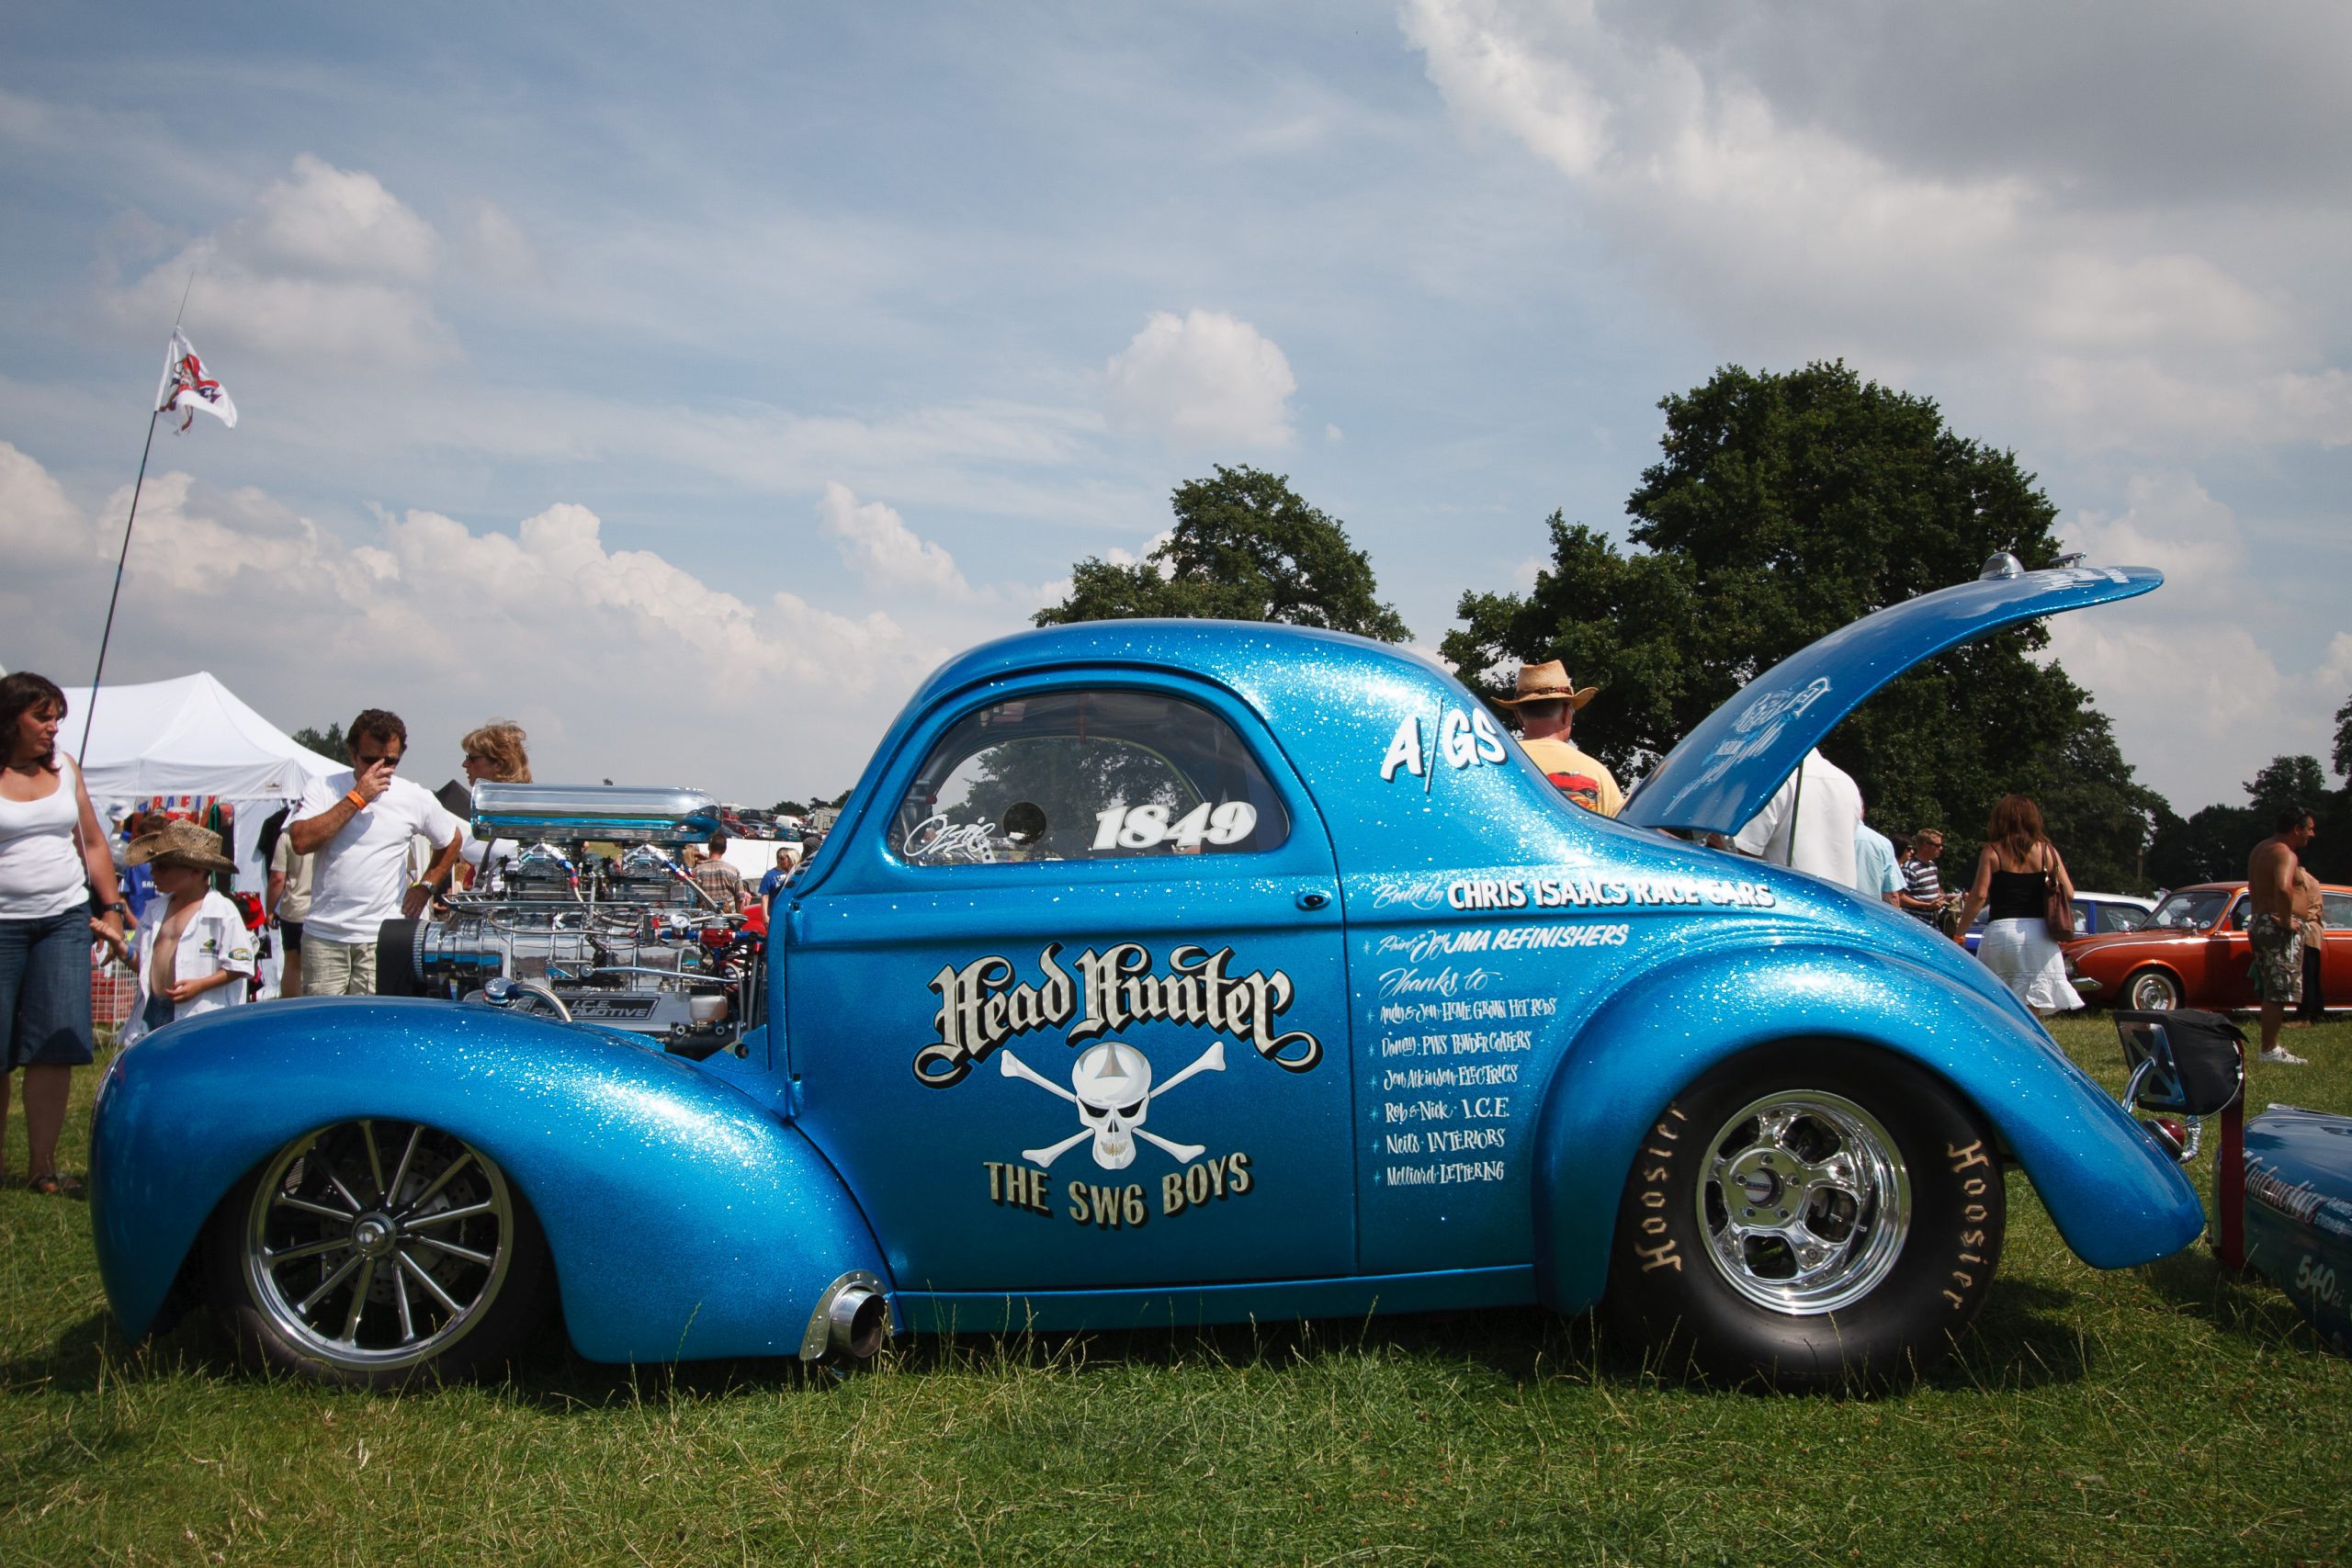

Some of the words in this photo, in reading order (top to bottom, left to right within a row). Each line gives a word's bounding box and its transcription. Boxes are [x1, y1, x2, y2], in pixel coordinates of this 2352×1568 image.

[1091, 801, 1258, 851] 1849
[1374, 883, 1426, 908] Built
[1418, 881, 1445, 910] by
[1447, 879, 1529, 911] CHRIS
[1530, 878, 1631, 908] ISAACS
[1633, 877, 1702, 907] RACE
[1706, 879, 1776, 908] CARS
[1444, 930, 1491, 954] JMA
[1491, 923, 1630, 951] REFINISHERS
[1463, 967, 1501, 991] to
[571, 999, 611, 1009] I.C.E.
[911, 942, 1078, 1089] Head
[1065, 942, 1323, 1075] Hunter
[1422, 1033, 1448, 1055] PWS
[1385, 1101, 1408, 1122] Rob
[1418, 1100, 1453, 1122] Nick
[1461, 1097, 1510, 1120] I.C.E.
[1427, 1128, 1507, 1153] INTERIORS
[983, 1161, 1054, 1218] THE
[1069, 1180, 1149, 1230] SW6
[1161, 1152, 1255, 1219] BOYS
[1942, 1139, 1991, 1311] Hoosier
